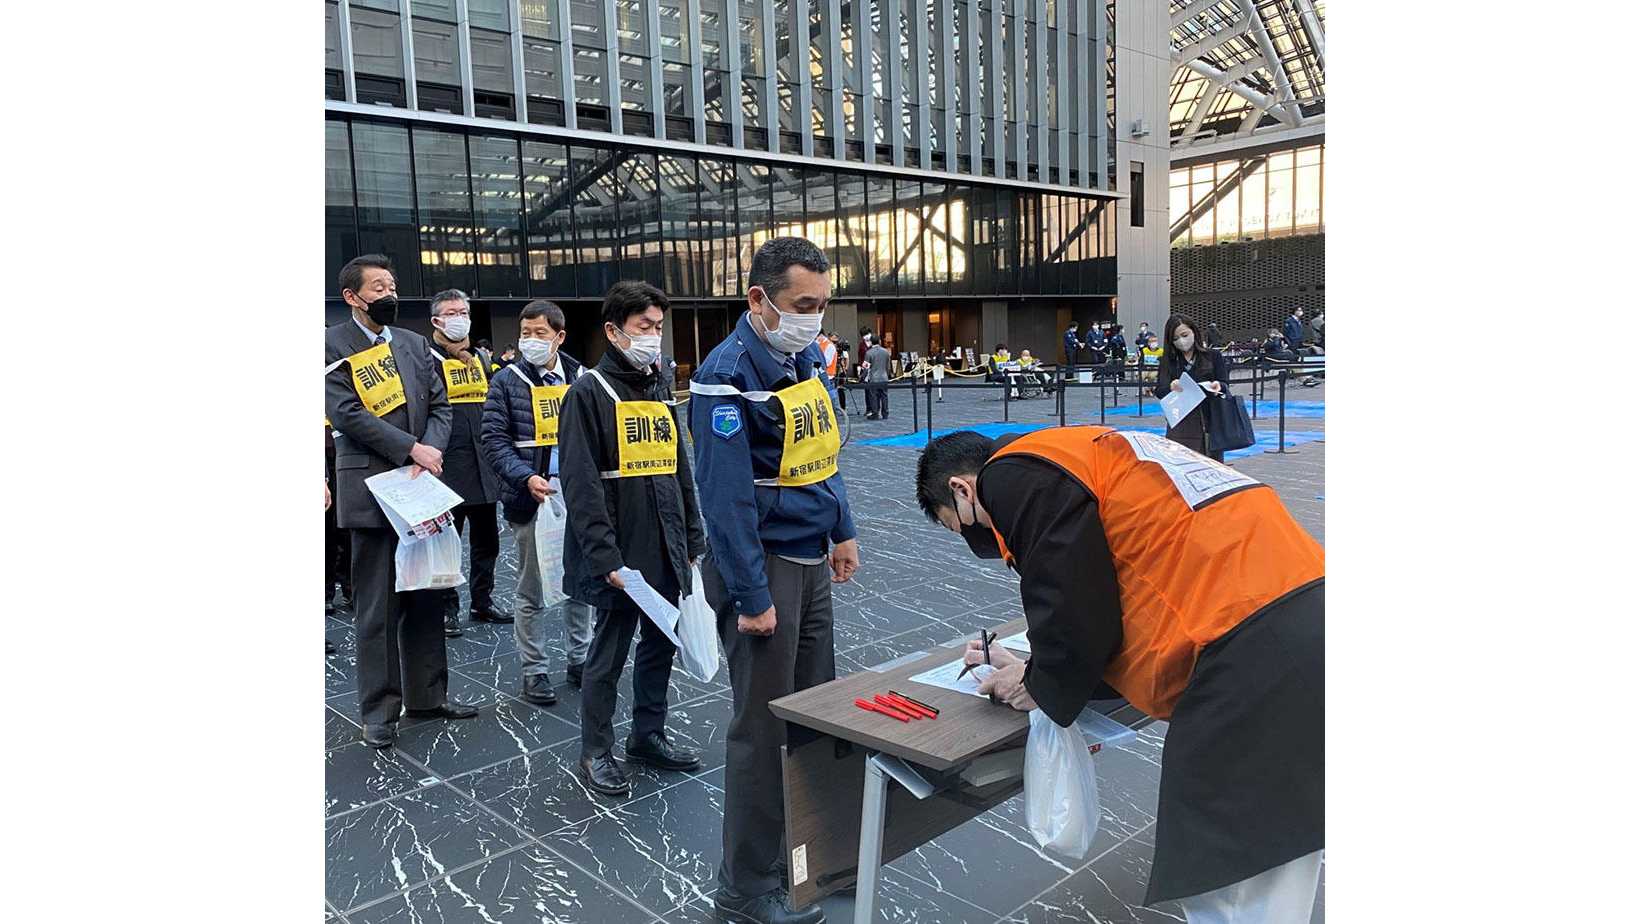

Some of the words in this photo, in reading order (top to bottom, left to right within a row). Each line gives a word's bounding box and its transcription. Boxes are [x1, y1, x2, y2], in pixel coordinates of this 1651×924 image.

[355, 354, 398, 391] 訓練
[624, 415, 672, 444] 訓練
[790, 399, 832, 444] 訓練
